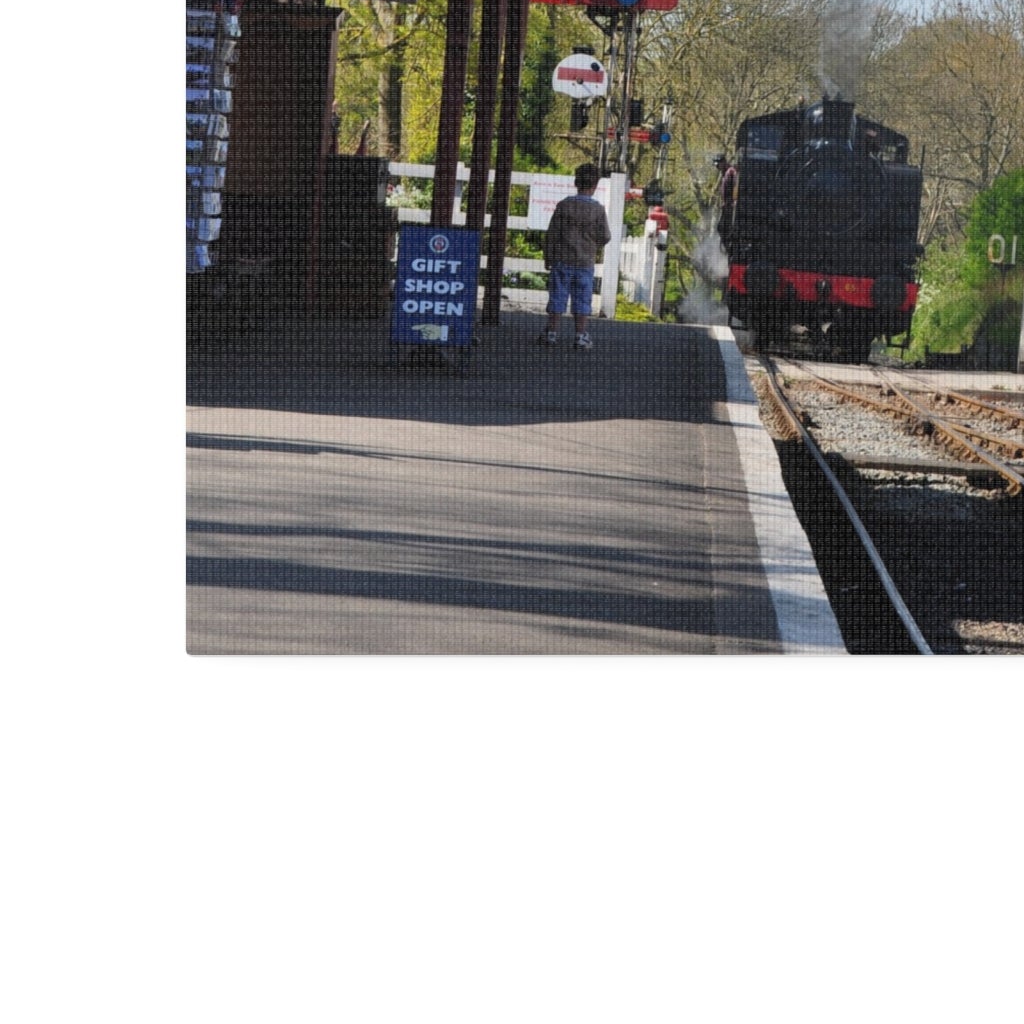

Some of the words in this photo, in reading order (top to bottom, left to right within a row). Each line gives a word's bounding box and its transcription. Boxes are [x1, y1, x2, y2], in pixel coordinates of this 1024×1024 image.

[411, 258, 462, 274] GIFT
[404, 279, 465, 295] SHOP
[402, 299, 464, 316] OPEN
